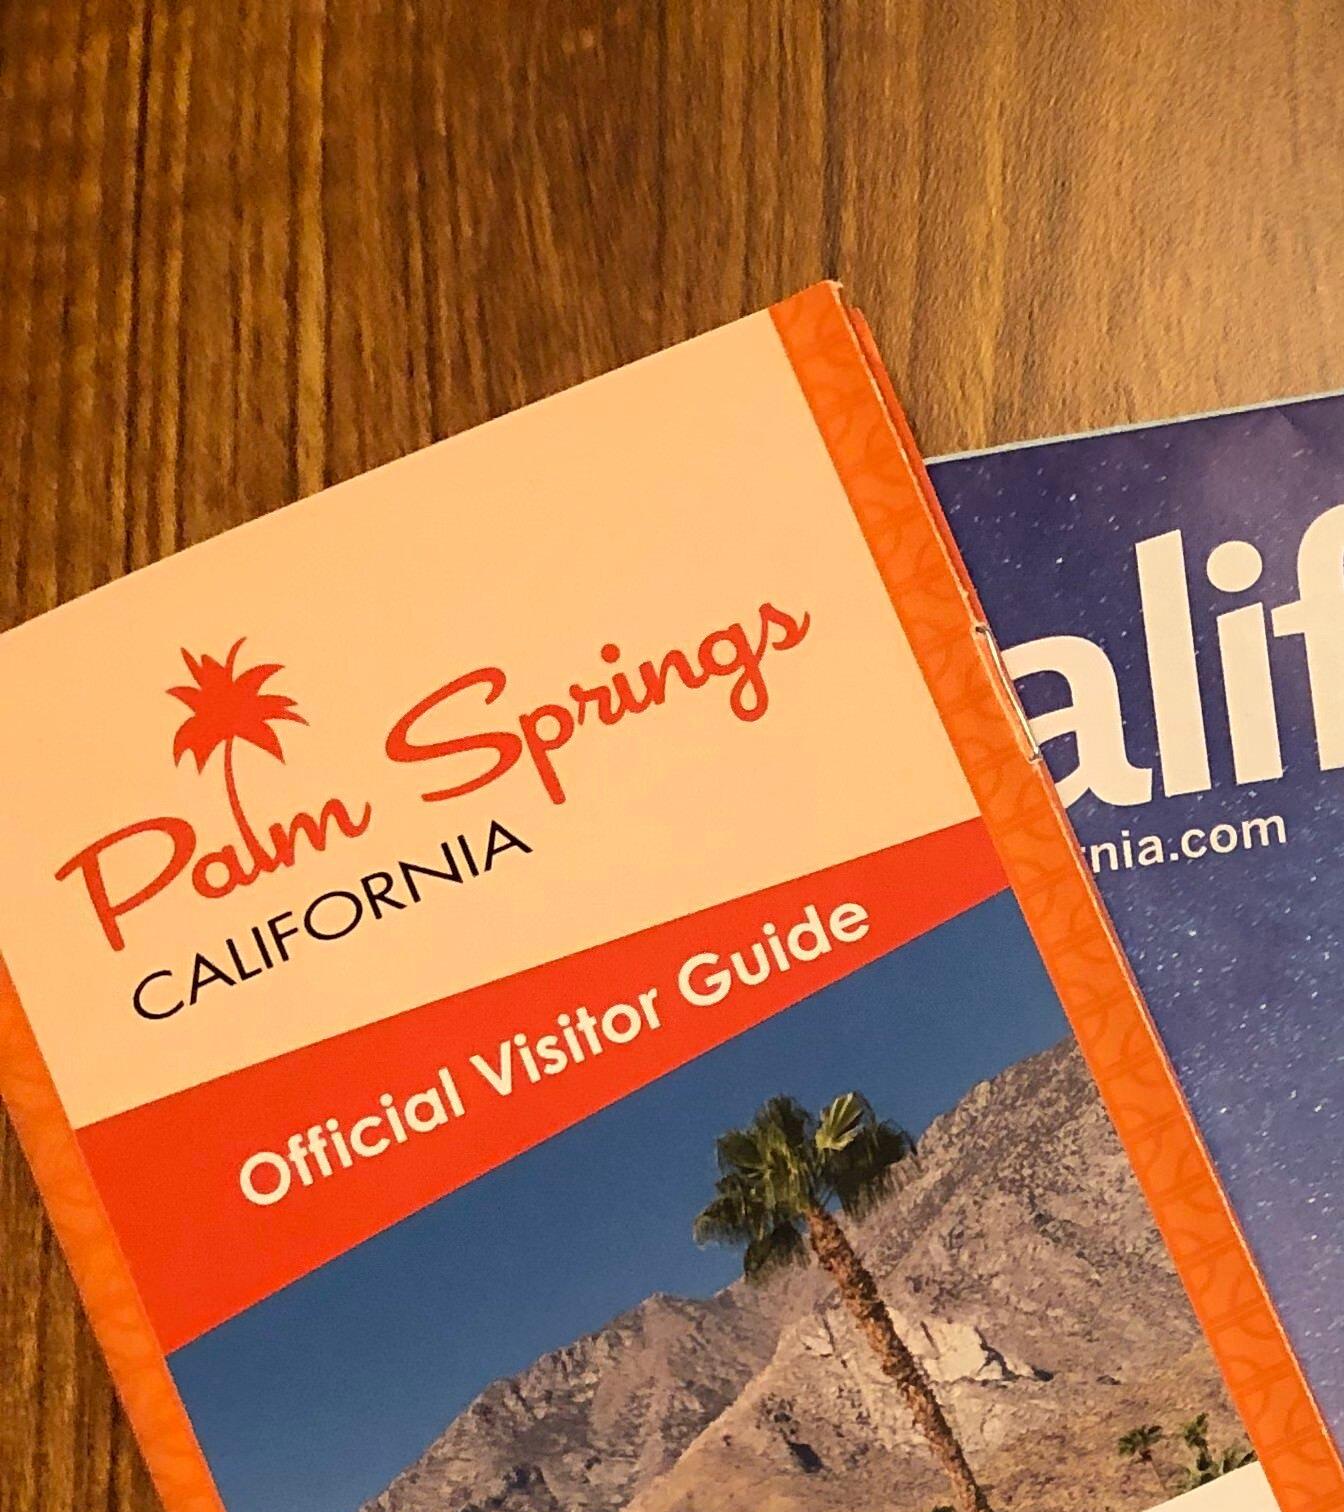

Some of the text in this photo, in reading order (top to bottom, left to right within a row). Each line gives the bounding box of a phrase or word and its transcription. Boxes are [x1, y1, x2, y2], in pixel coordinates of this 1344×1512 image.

[54, 602, 811, 952] Palm Springs
[1081, 814, 1288, 874] nia.com
[131, 820, 533, 1021] CALIFORNIA
[239, 901, 871, 1208] Official Visitor Guide
